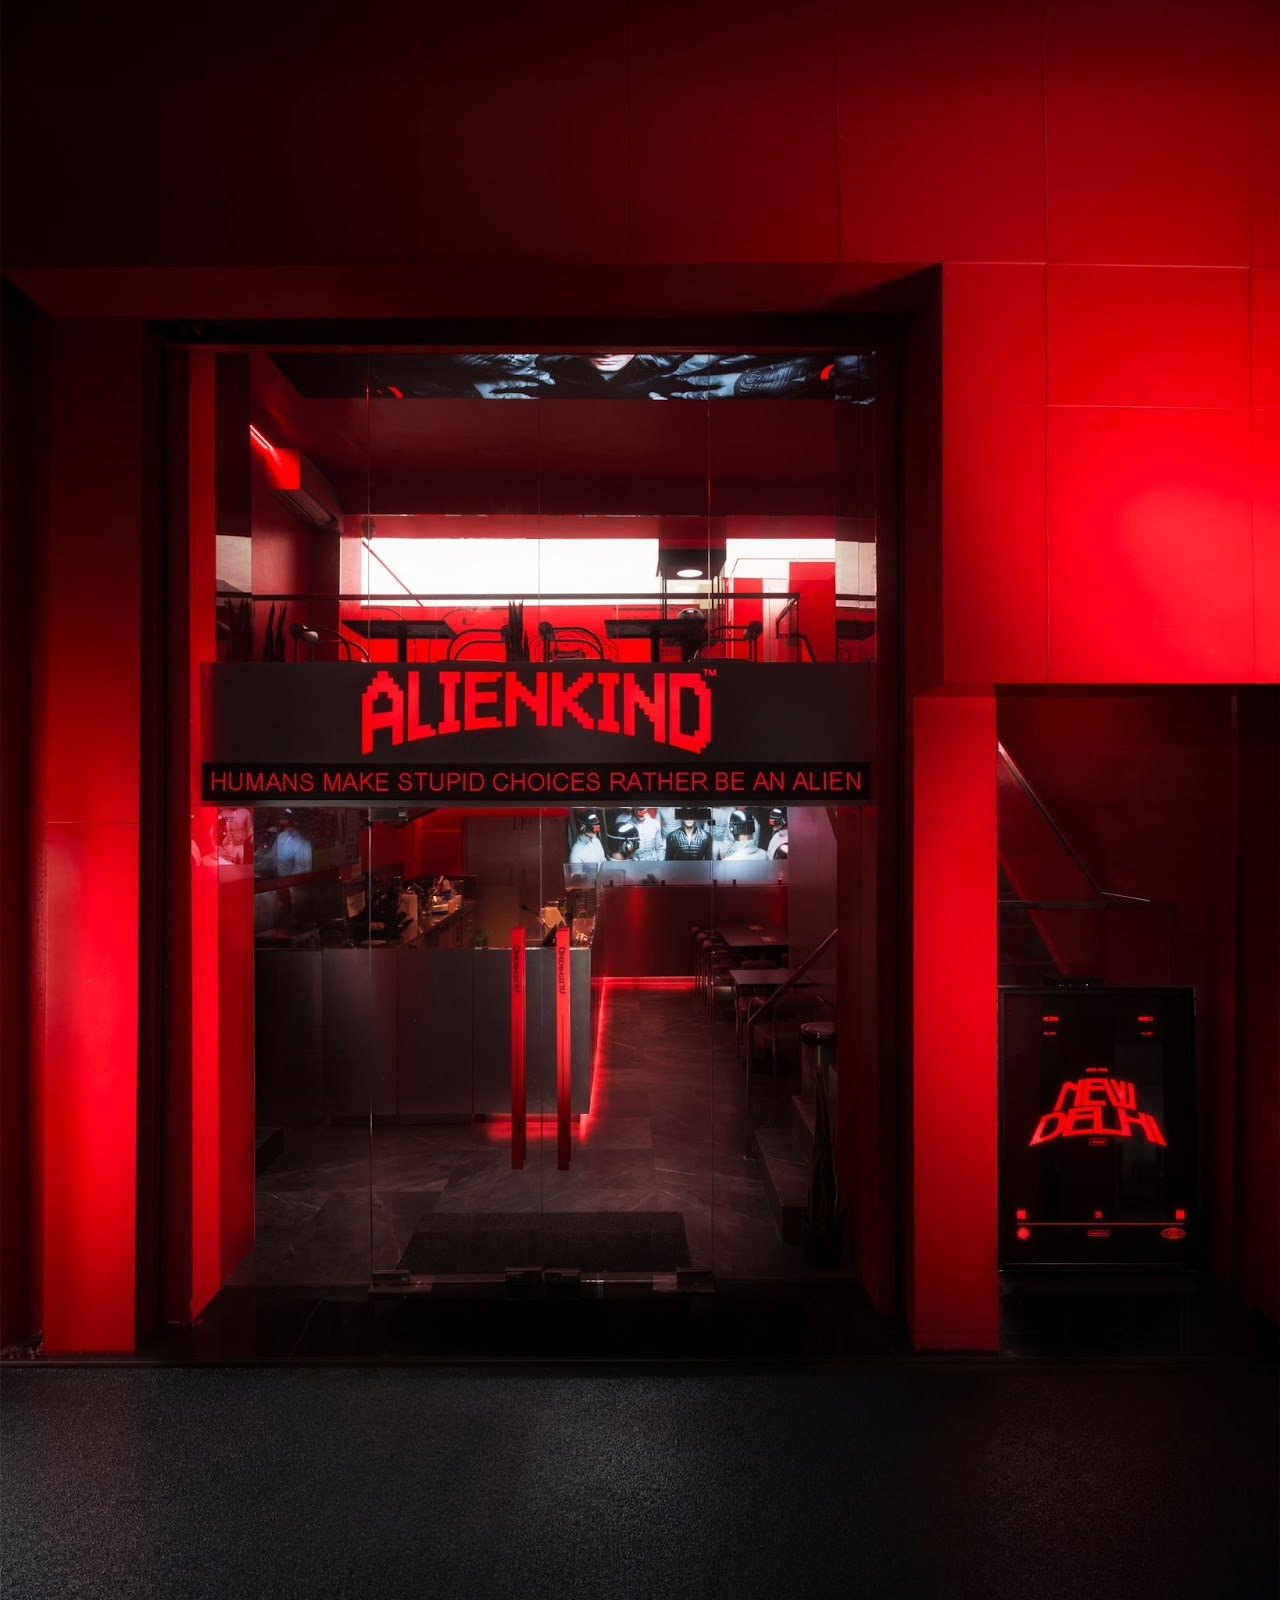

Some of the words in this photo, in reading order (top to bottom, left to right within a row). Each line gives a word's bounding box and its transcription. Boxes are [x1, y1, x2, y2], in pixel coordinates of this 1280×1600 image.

[361, 670, 712, 755] ALIENKIND
[211, 772, 315, 792] HUMANS
[323, 772, 389, 792] MAKE
[397, 772, 486, 792] STUPID
[493, 772, 601, 792] CHOICES
[610, 772, 708, 791] RATHER
[715, 772, 745, 791] BE
[753, 772, 785, 791] AN
[793, 771, 862, 791] ALIEN
[558, 947, 566, 994] ALIENKIND
[1053, 1078, 1137, 1111] NEW
[1029, 1106, 1168, 1147] DELHI
